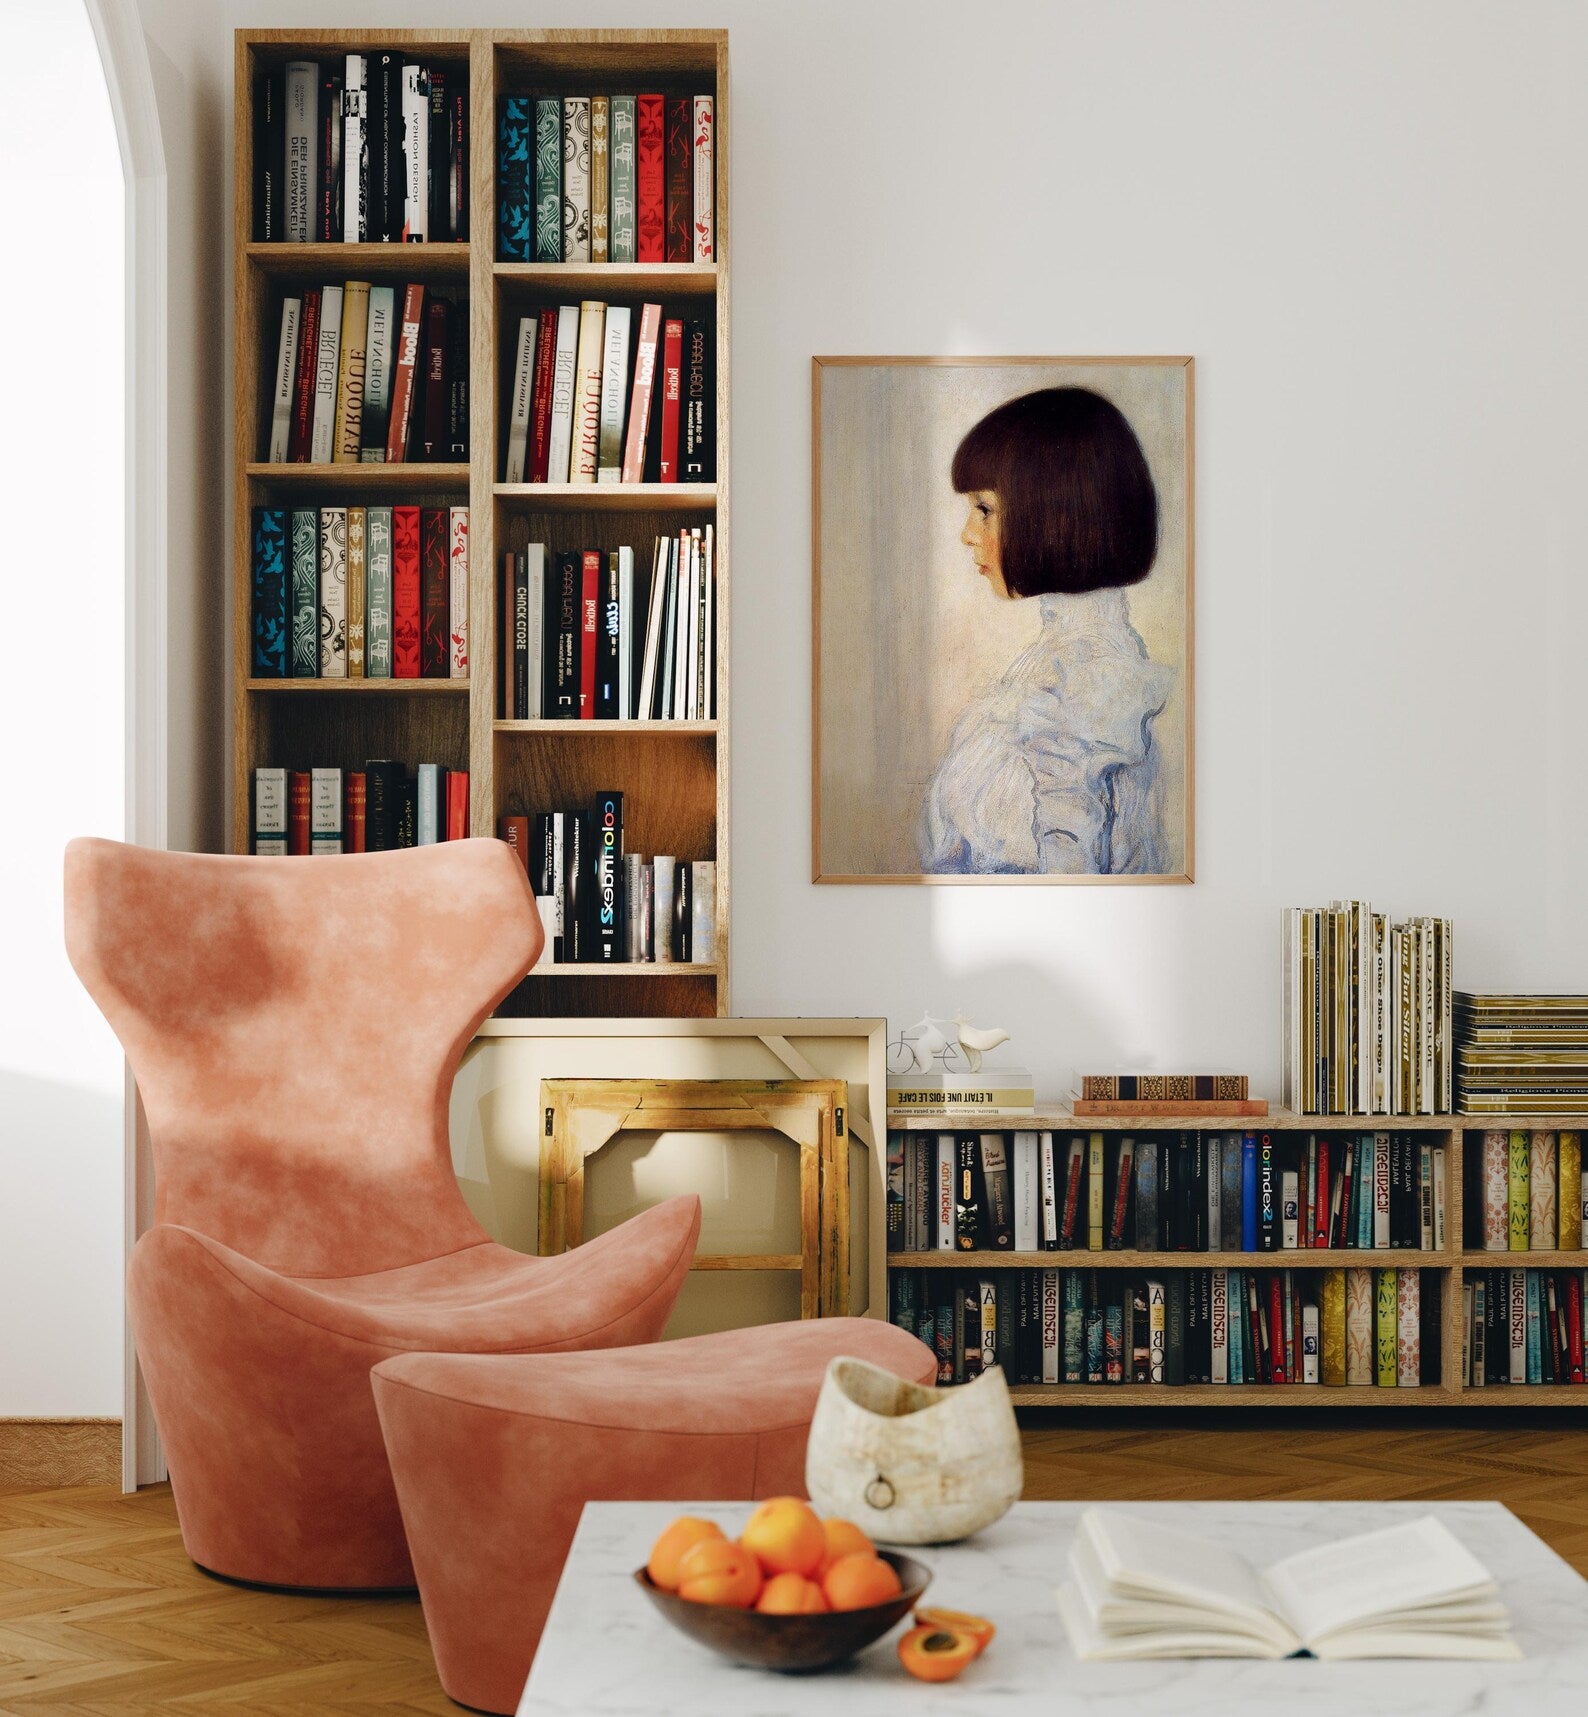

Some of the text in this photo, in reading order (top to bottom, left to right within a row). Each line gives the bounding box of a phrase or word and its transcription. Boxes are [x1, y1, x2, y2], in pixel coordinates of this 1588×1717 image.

[898, 1093, 916, 1104] CAFÉ
[919, 1093, 928, 1102] LE
[930, 1093, 945, 1102] FOIS
[948, 1093, 962, 1102] UNE
[986, 1093, 992, 1102] IL
[1262, 1134, 1273, 1222] olorindex2
[1044, 1272, 1056, 1348] JUGENDSTIL
[1214, 1272, 1226, 1348] JUGENDSTIL
[1512, 1273, 1524, 1348] JUGENDSTIL
